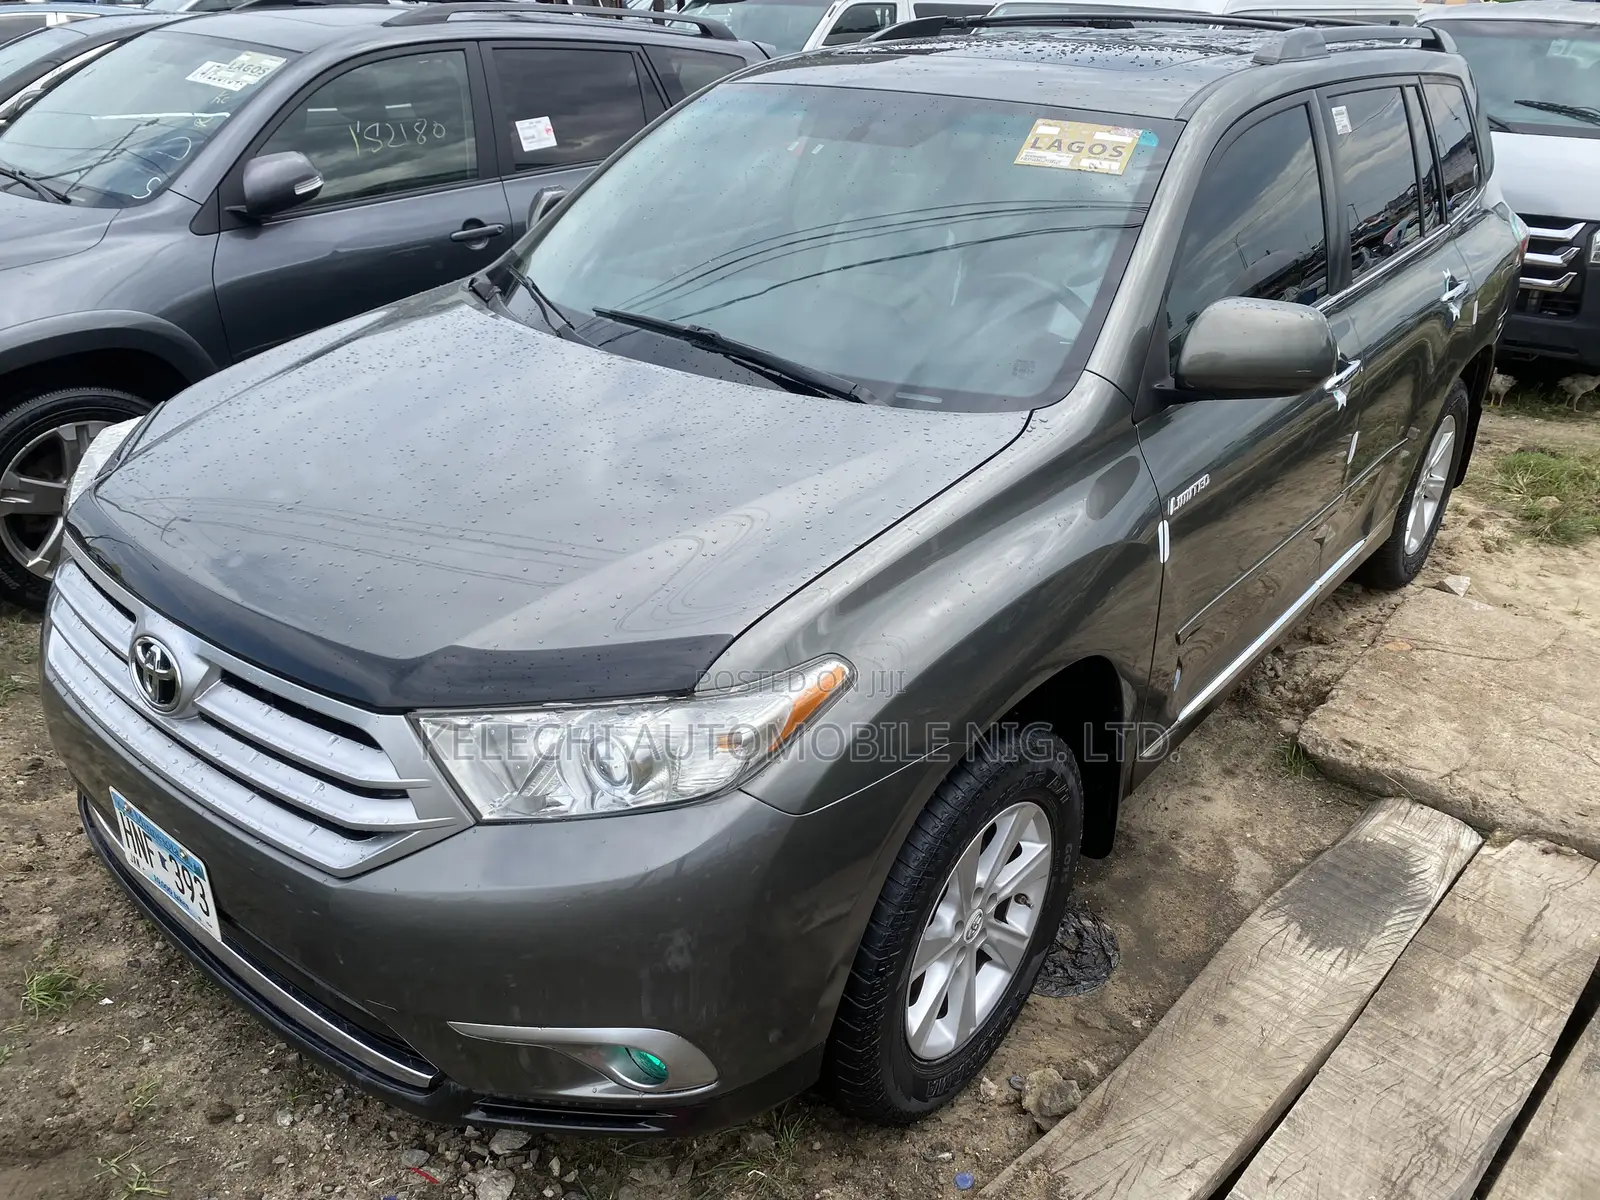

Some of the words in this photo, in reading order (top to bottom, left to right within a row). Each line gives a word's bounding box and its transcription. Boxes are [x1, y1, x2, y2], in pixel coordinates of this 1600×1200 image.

[228, 61, 271, 76] LAGOS
[1029, 136, 1127, 159] LAGOS
[119, 811, 155, 869] HNF
[169, 854, 210, 918] 393
